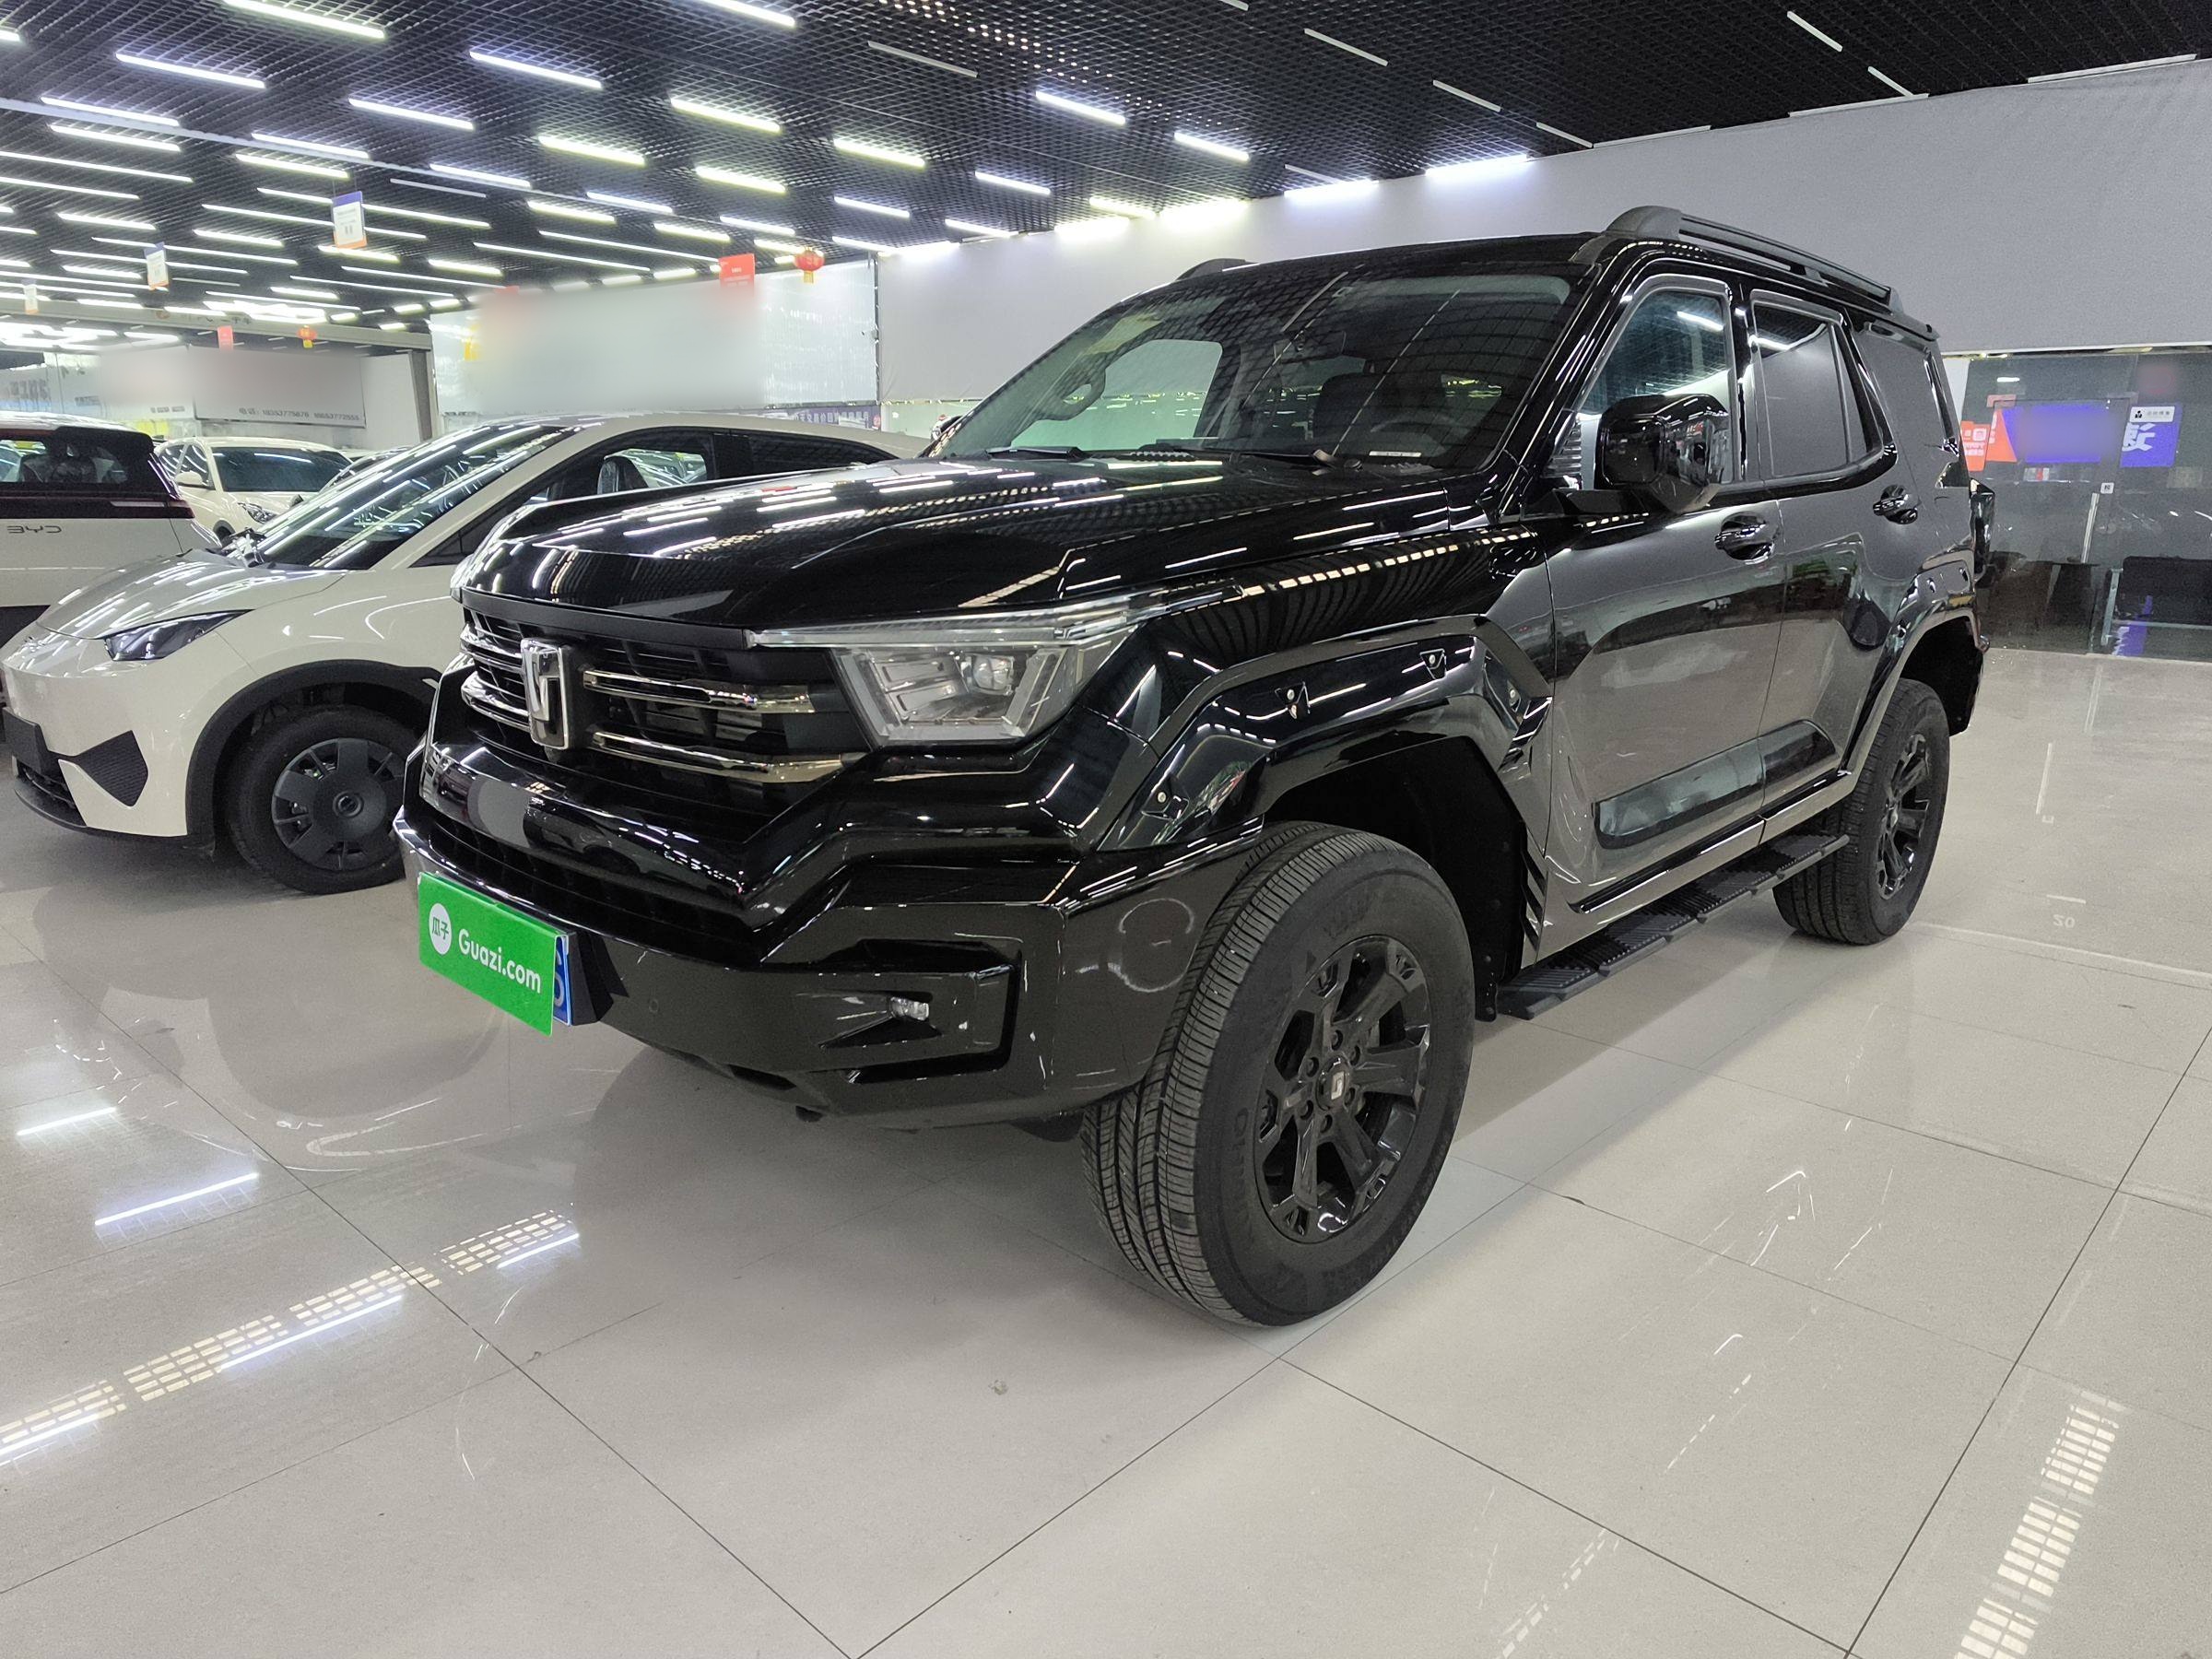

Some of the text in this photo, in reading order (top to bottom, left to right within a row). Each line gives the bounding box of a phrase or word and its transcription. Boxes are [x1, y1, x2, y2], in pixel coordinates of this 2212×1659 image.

[6, 525, 63, 534] BYD
[431, 916, 450, 940] 瓜子
[458, 928, 542, 994] Guazi.com
